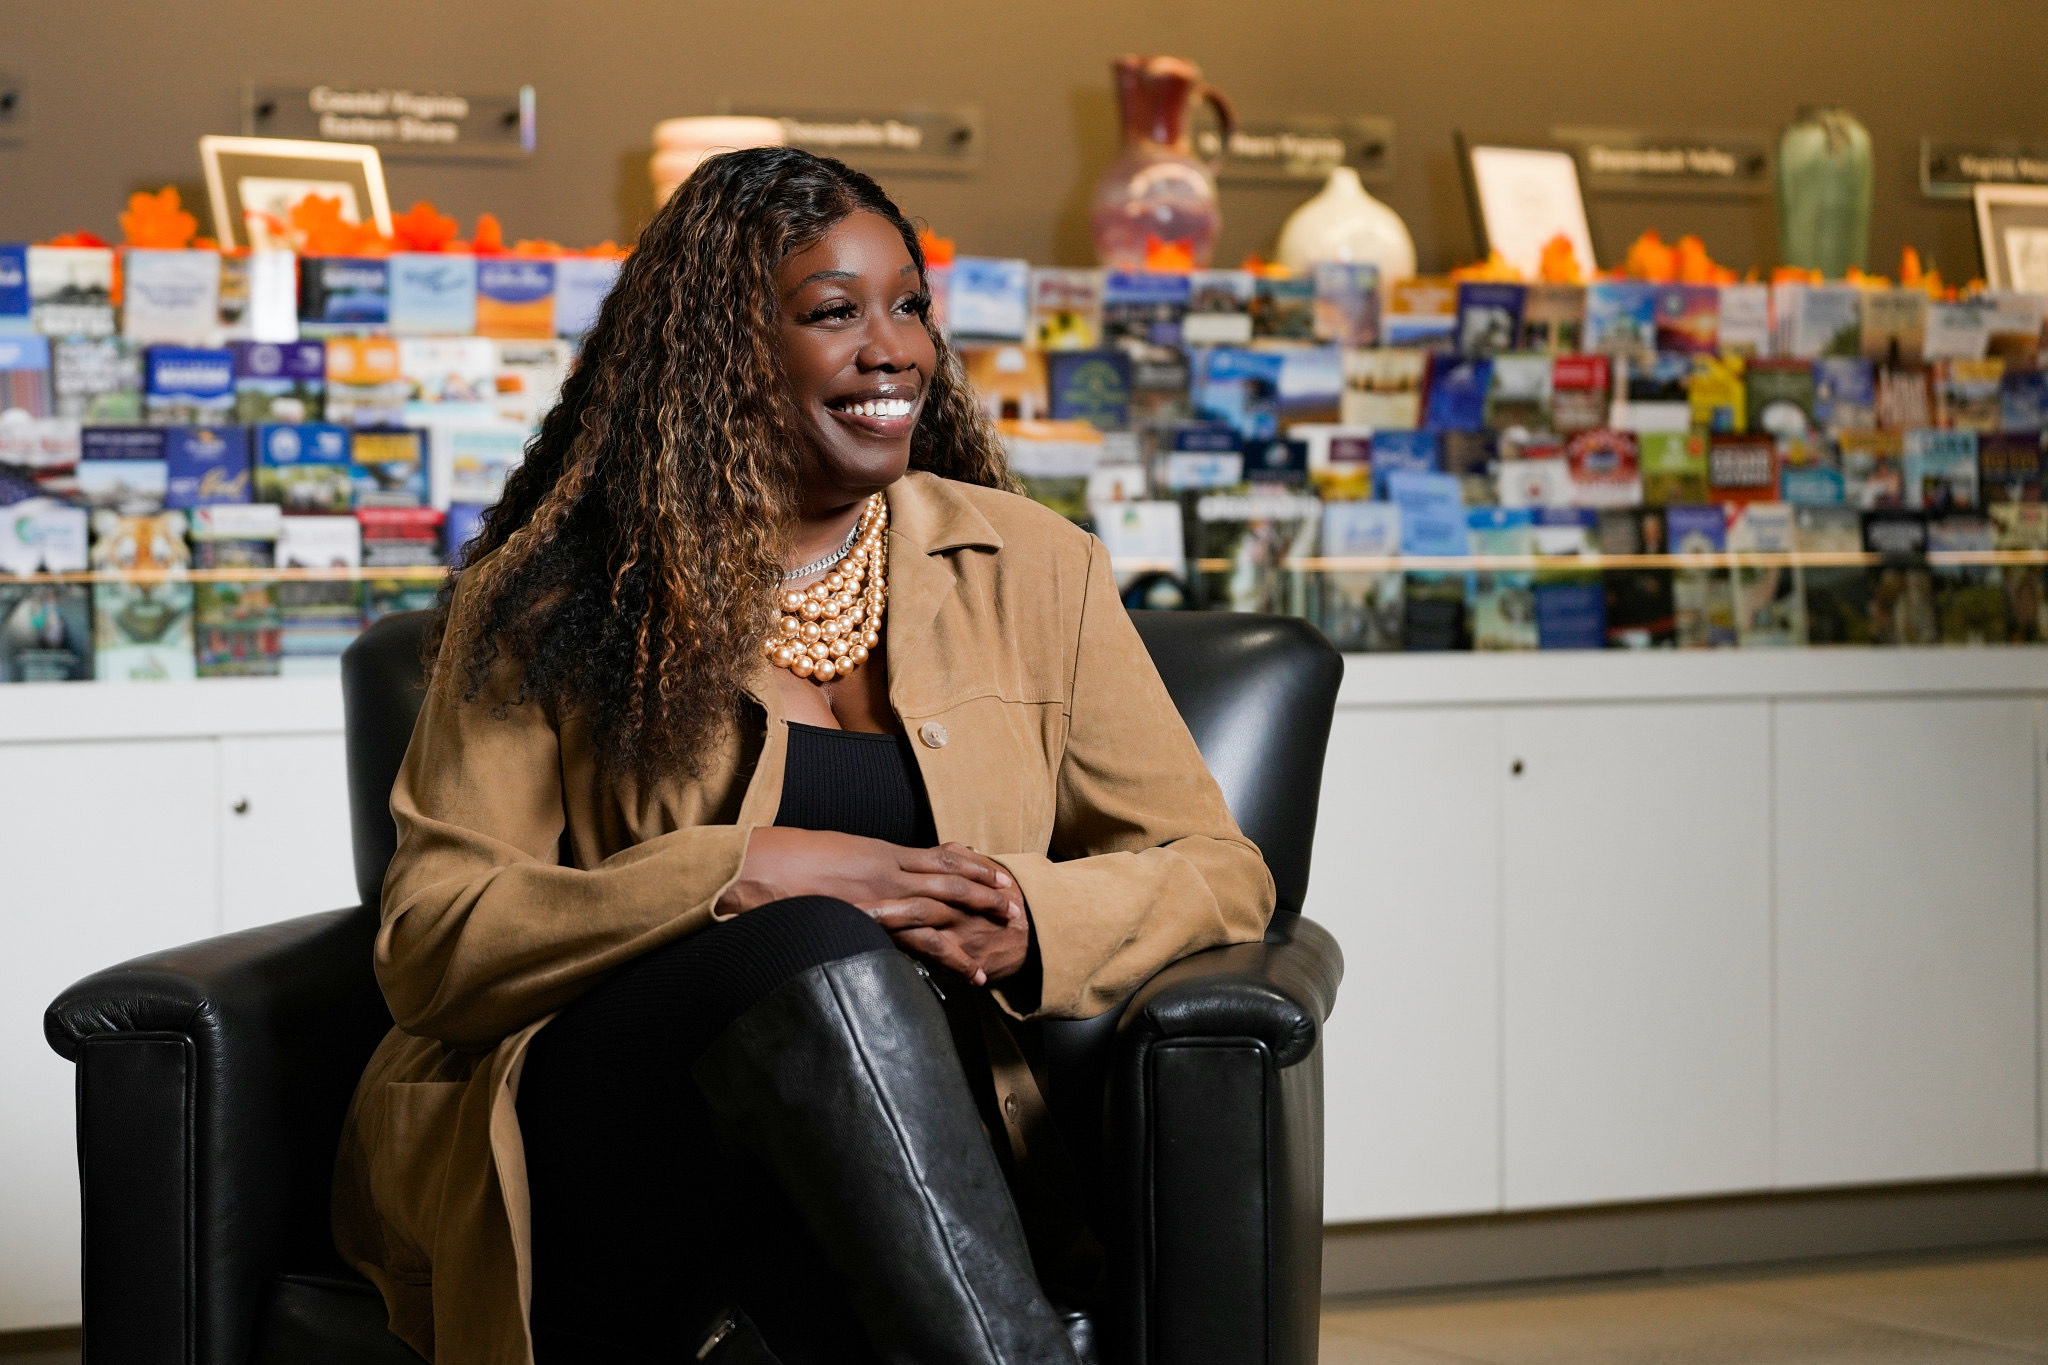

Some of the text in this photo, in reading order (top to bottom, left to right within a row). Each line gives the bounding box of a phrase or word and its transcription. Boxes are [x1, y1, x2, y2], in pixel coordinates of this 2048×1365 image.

[309, 87, 468, 119] Coastal Virginia
[319, 112, 458, 142] Eastern Shore
